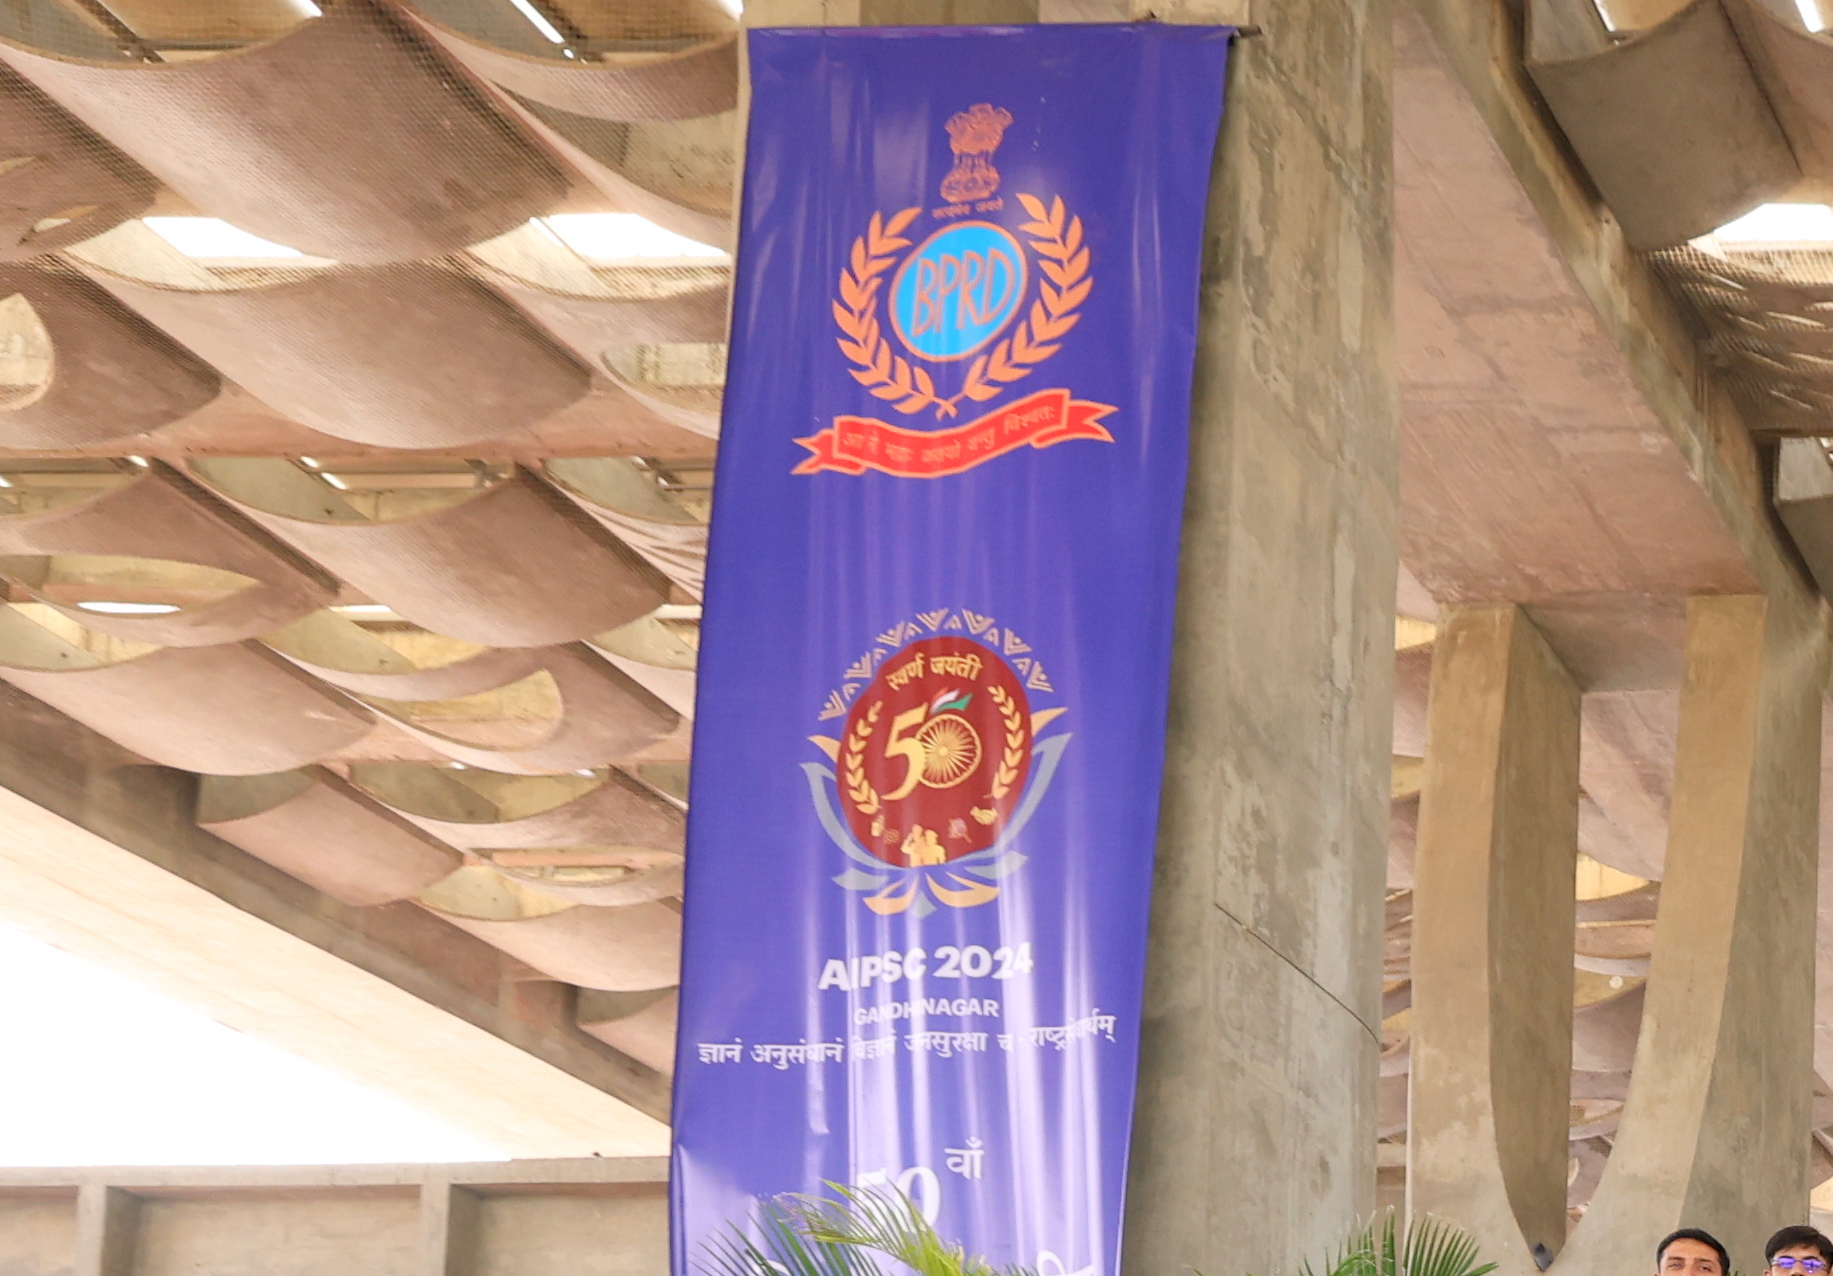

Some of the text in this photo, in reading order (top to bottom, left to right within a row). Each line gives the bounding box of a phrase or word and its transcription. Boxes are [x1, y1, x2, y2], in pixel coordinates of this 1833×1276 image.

[911, 247, 1015, 338] BPRD
[885, 651, 984, 692] स्वर्ण जयंती
[817, 941, 1034, 991] AIPSC 2024
[697, 1037, 744, 1065] ज्ञानं
[750, 1036, 845, 1070] अनुसंधानं
